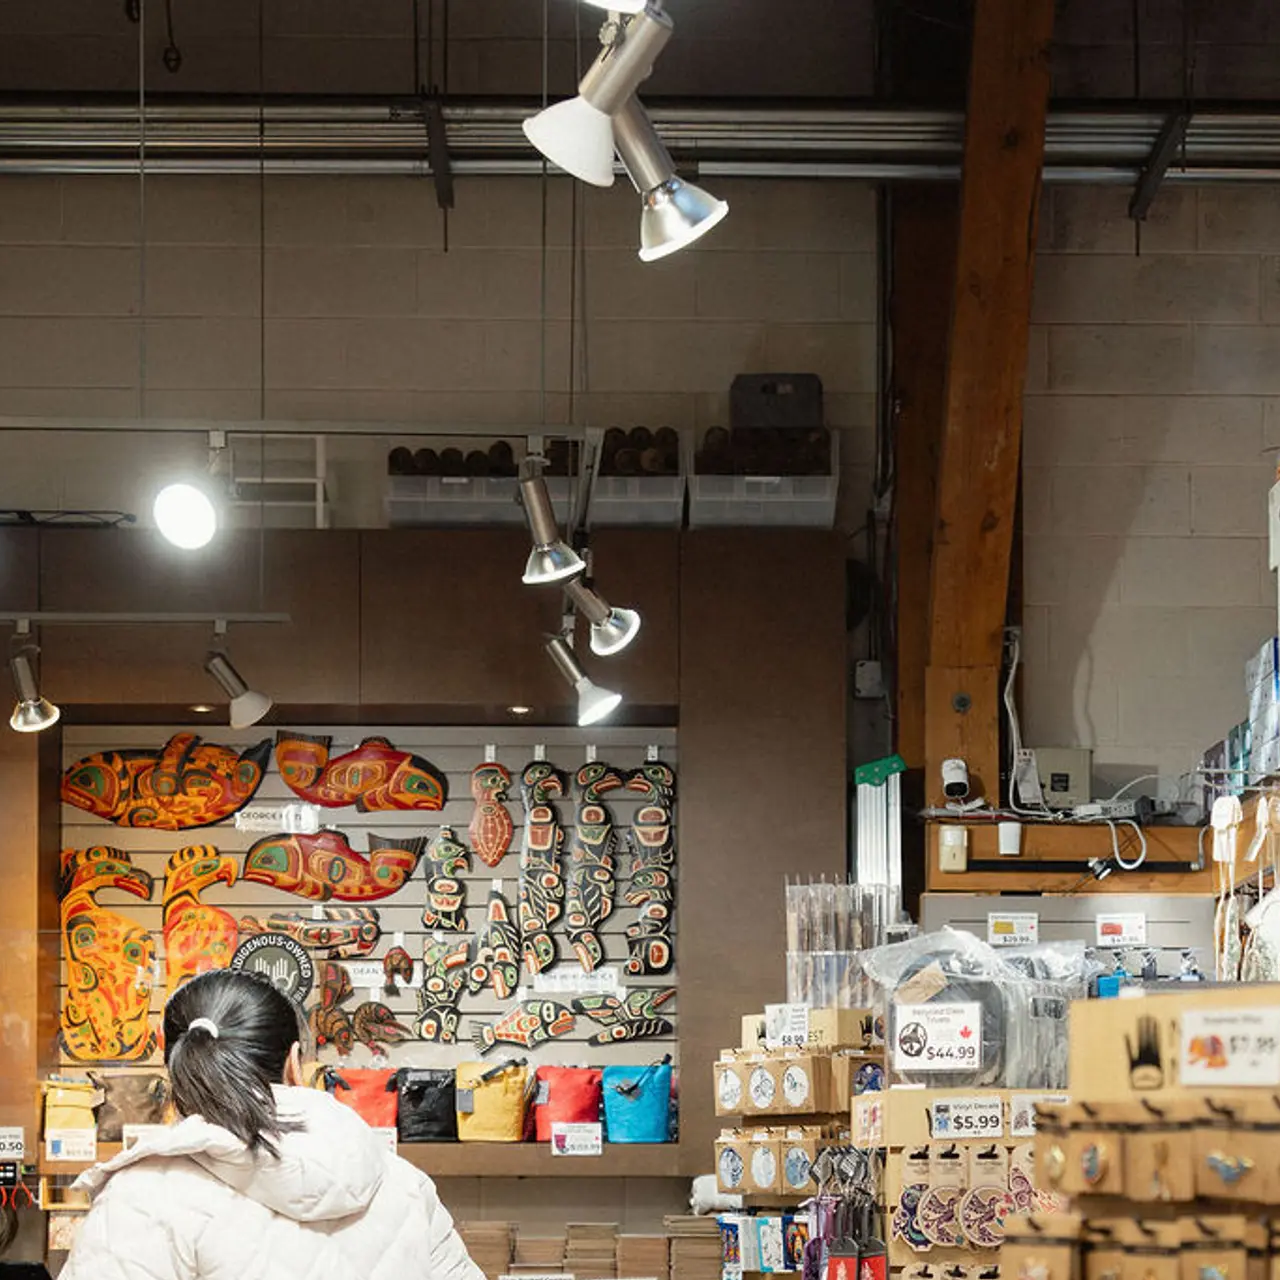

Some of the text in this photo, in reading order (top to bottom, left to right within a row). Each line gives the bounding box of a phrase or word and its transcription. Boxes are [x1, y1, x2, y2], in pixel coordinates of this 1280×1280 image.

[241, 812, 277, 821] GEORGE
[232, 935, 312, 979] DIGENOUS-OWNED
[1229, 1034, 1278, 1055] $7.99
[926, 1046, 976, 1060] $44.99
[952, 1115, 1000, 1131] $5.99
